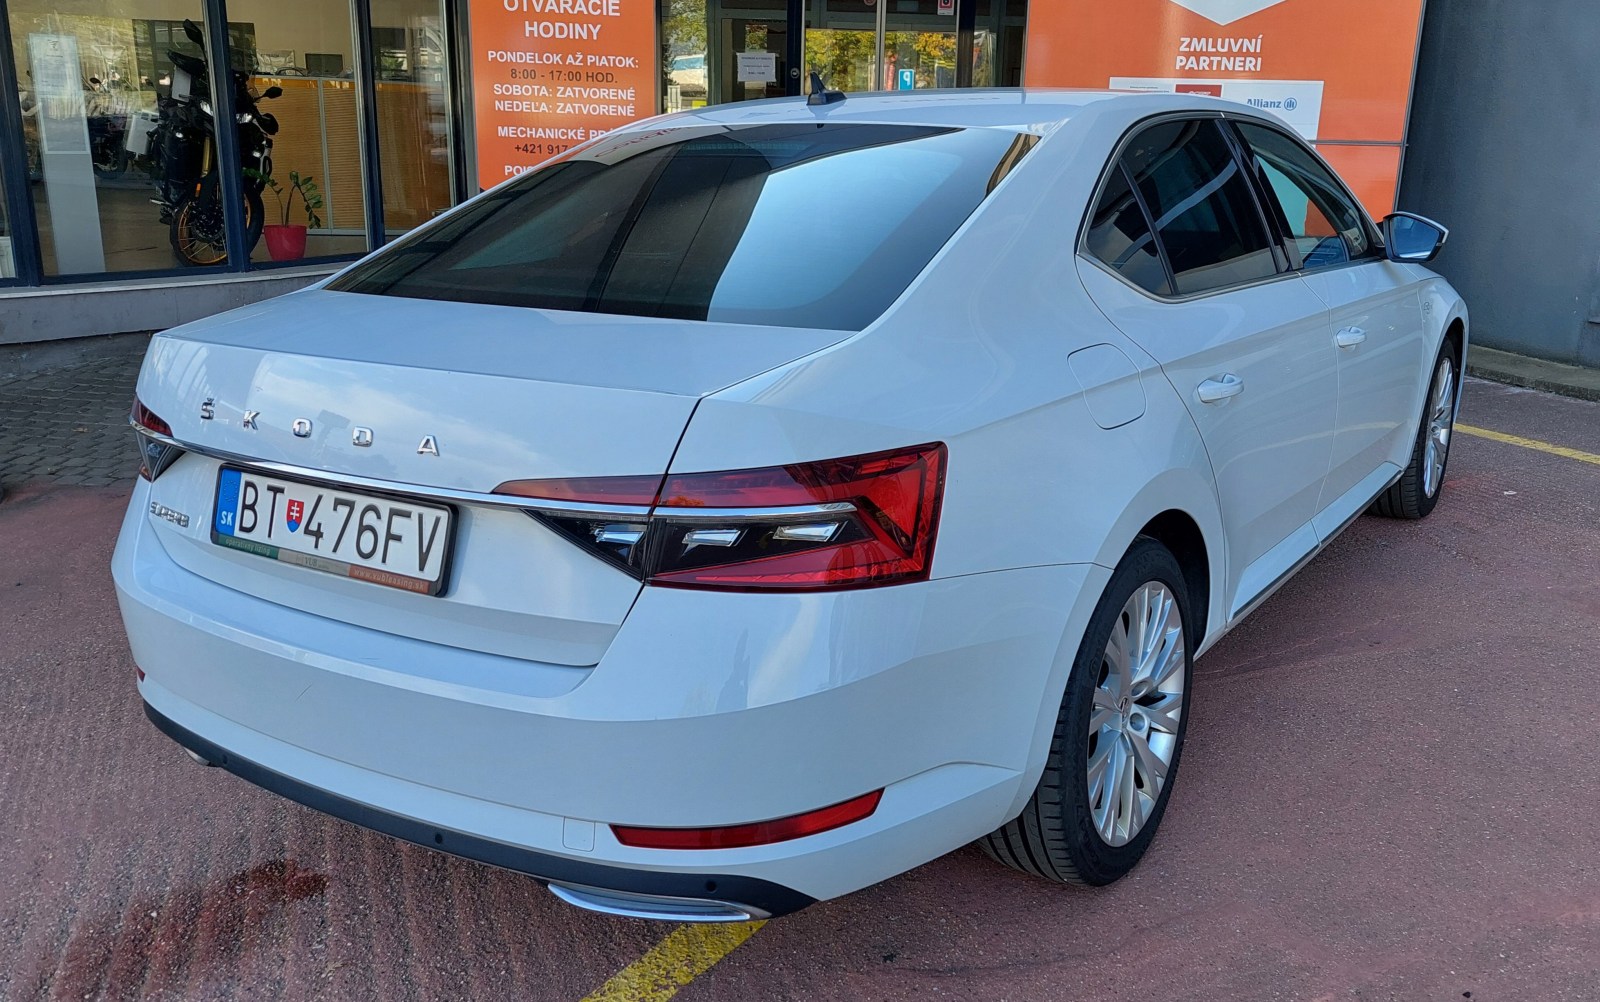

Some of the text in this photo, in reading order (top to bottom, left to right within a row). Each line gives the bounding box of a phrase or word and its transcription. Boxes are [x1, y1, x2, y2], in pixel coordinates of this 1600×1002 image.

[524, 21, 602, 40] HODINY
[1179, 34, 1263, 52] ZMLUVNÍ
[487, 50, 639, 68] PONDELOK AŽ PIATOK:
[1175, 55, 1262, 71] PARTNERI
[511, 68, 536, 80] 8:00
[549, 70, 582, 81] 17:00
[586, 72, 618, 83] HOD.
[493, 84, 635, 100] SOBOTA: ZATVORENÉ
[495, 100, 635, 117] NEDEĽA: ZATVORENÉ
[1246, 98, 1282, 109] Allianz
[497, 126, 586, 140] MECHANICKÉ
[515, 143, 568, 155] +421 917
[200, 398, 440, 457] ŠKODA
[220, 510, 234, 527] SK
[239, 480, 442, 572] BT 476FV
